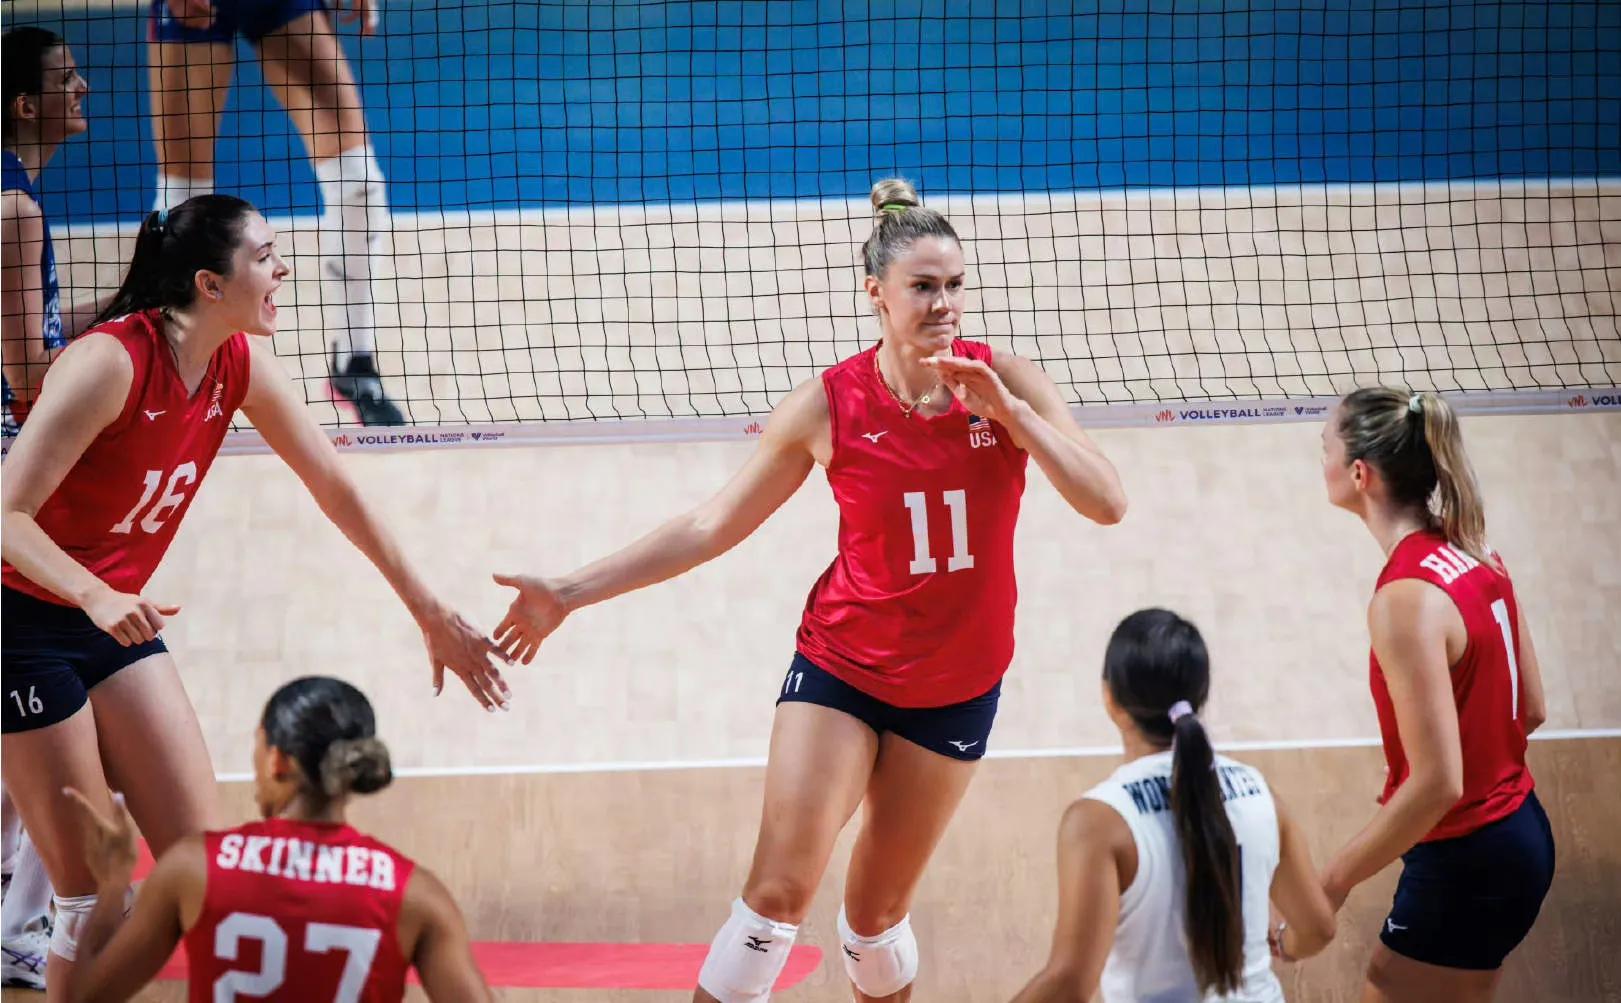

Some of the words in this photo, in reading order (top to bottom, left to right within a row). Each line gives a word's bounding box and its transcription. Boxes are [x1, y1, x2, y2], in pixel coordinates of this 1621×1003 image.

[356, 433, 438, 445] VOLLEYBALL
[1180, 408, 1261, 420] VOLLEYBALL
[109, 461, 197, 534] 16
[903, 489, 975, 575] 11
[785, 670, 804, 694] 11
[1490, 598, 1518, 720] 1
[9, 685, 44, 717] 16
[216, 833, 396, 892] SKINNER
[213, 911, 382, 1003] 27
